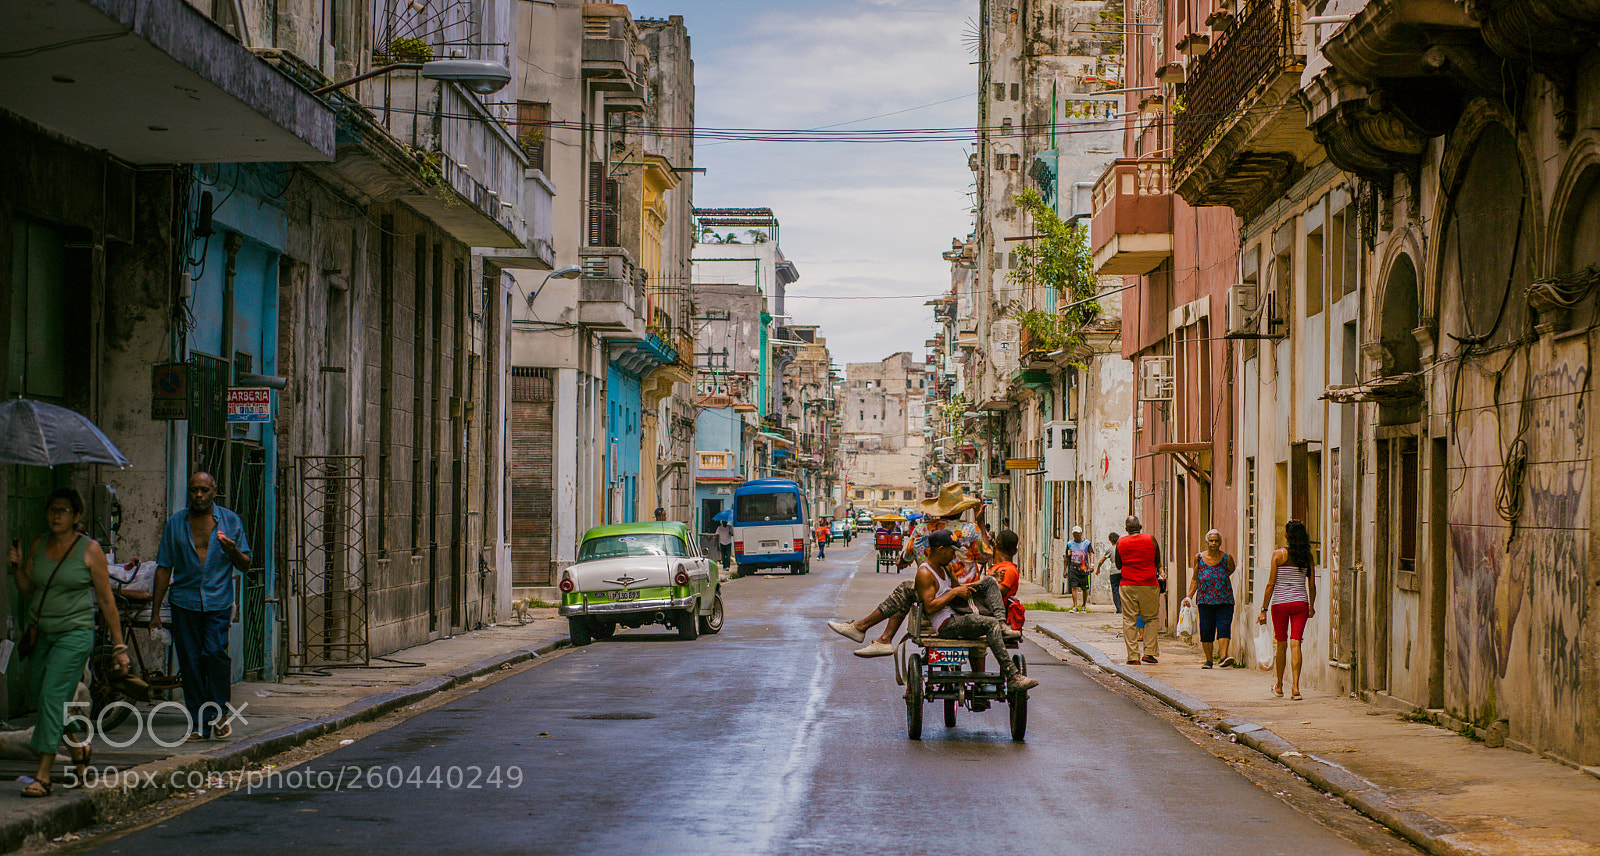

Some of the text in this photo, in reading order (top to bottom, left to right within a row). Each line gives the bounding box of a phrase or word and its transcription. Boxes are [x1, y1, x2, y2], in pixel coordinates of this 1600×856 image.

[227, 391, 269, 401] BARBERIA
[155, 408, 184, 417] CARGA
[939, 650, 966, 662] CUBA
